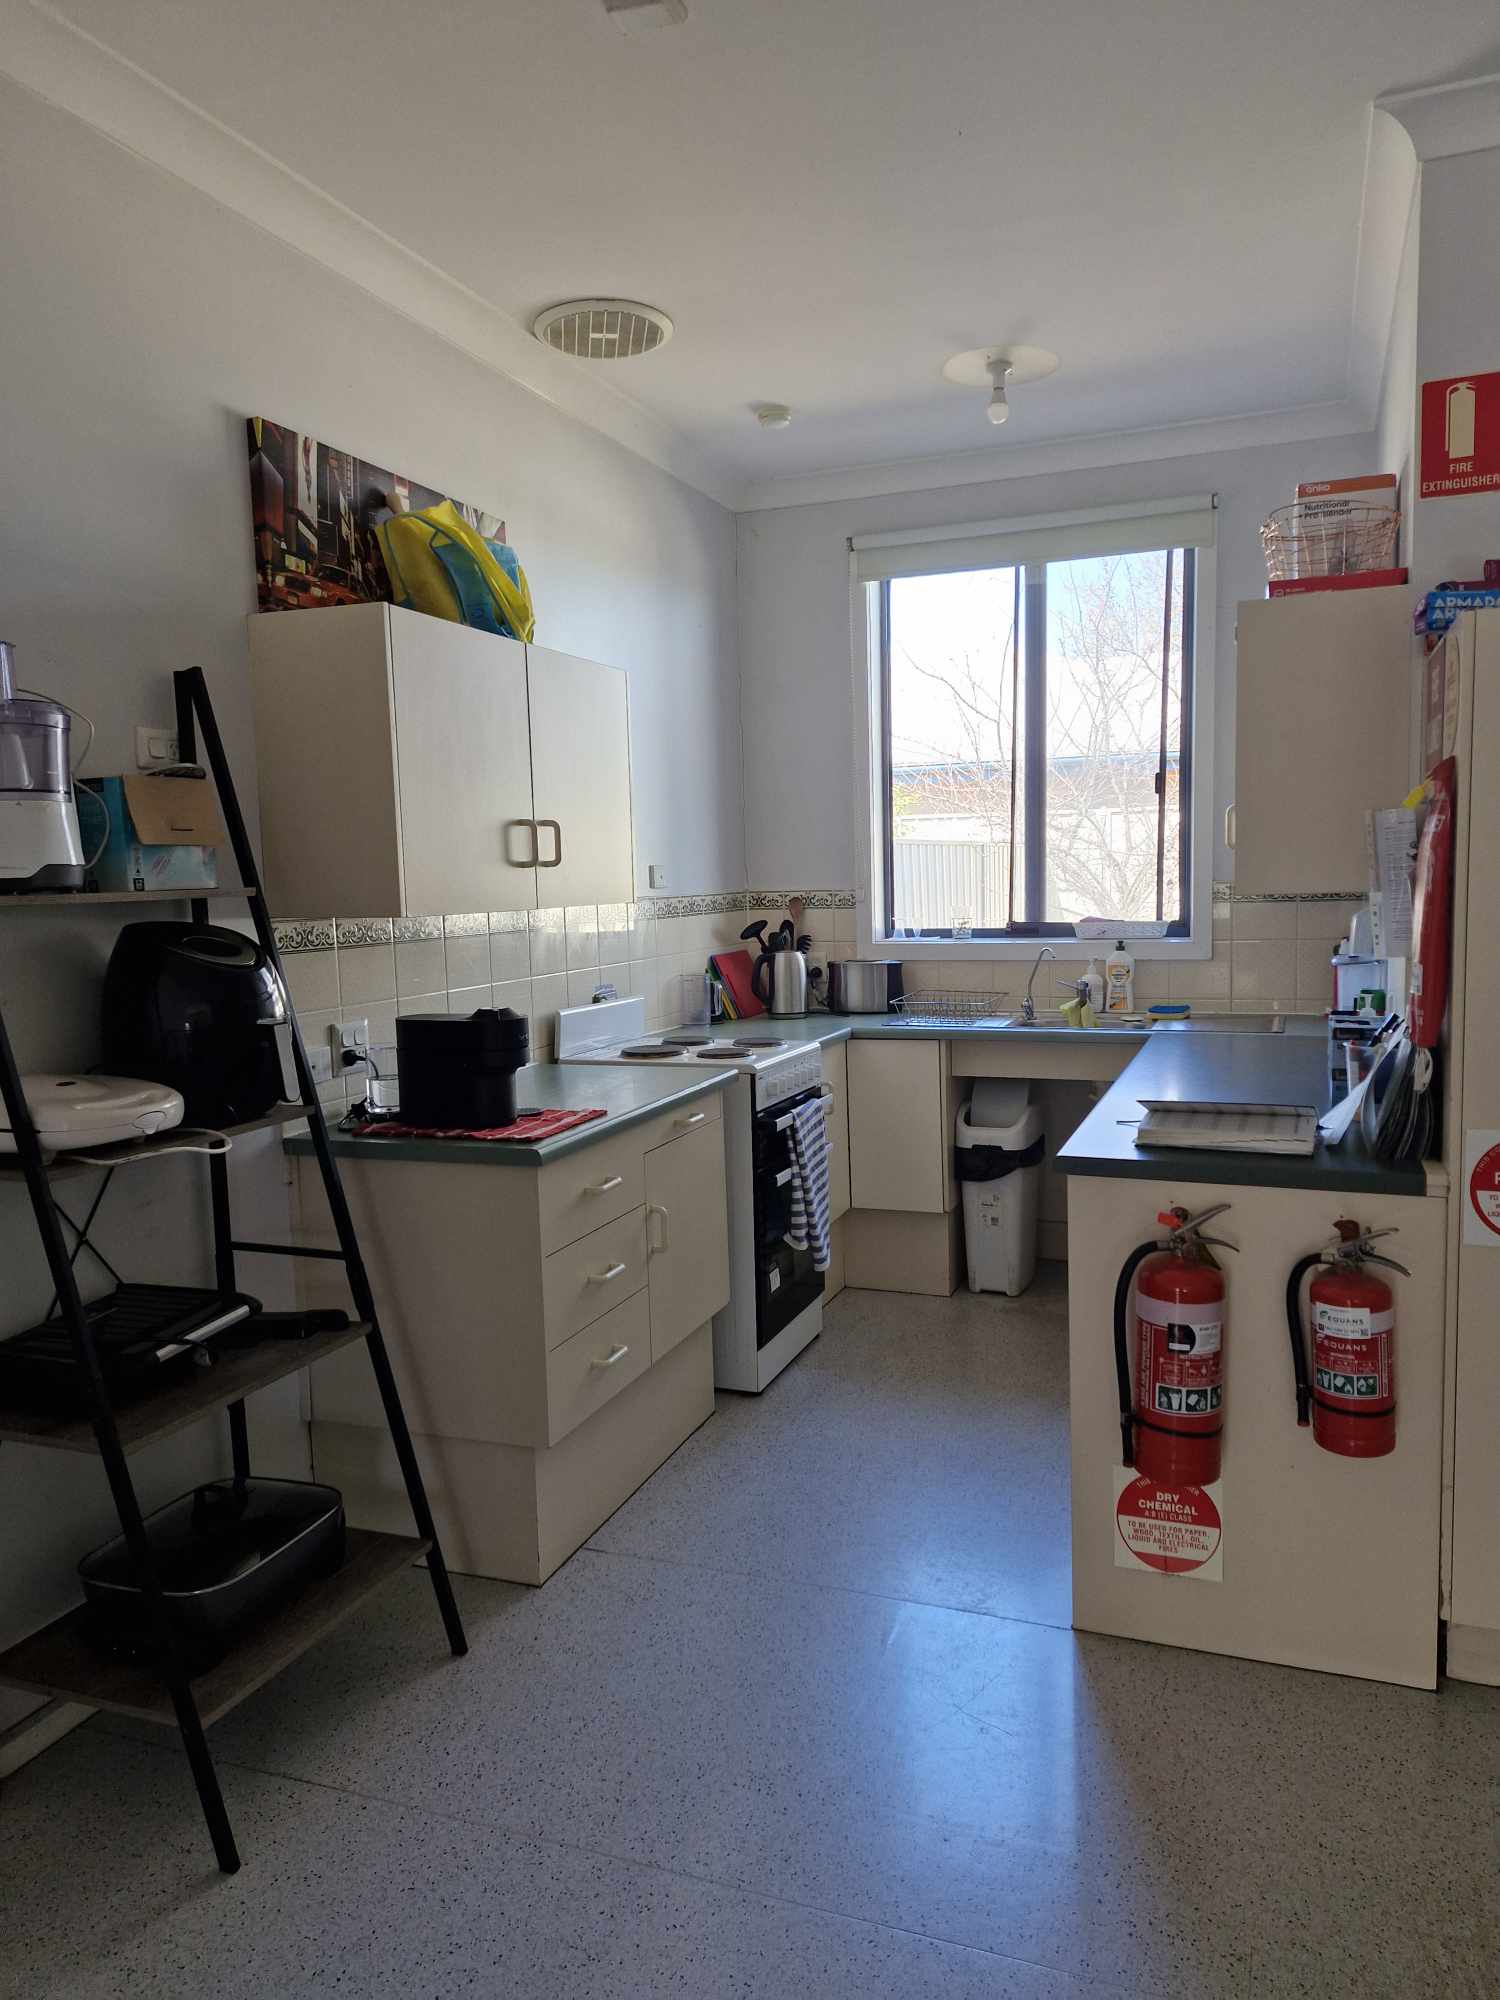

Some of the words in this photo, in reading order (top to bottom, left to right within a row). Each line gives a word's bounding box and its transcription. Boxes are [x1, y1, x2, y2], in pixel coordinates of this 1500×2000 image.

[1449, 462, 1473, 474] FIRE
[1422, 473, 1500, 493] EXTINGUISHER
[1156, 1491, 1180, 1502] DRY
[1138, 1499, 1199, 1516] CHEMICAL
[1169, 1513, 1193, 1523] CLASS
[1138, 1521, 1147, 1529] BE
[1148, 1523, 1167, 1532] USED
[1169, 1526, 1183, 1535] FOR
[1152, 1537, 1167, 1545] AND
[1168, 1539, 1210, 1551] ELECTRICAL
